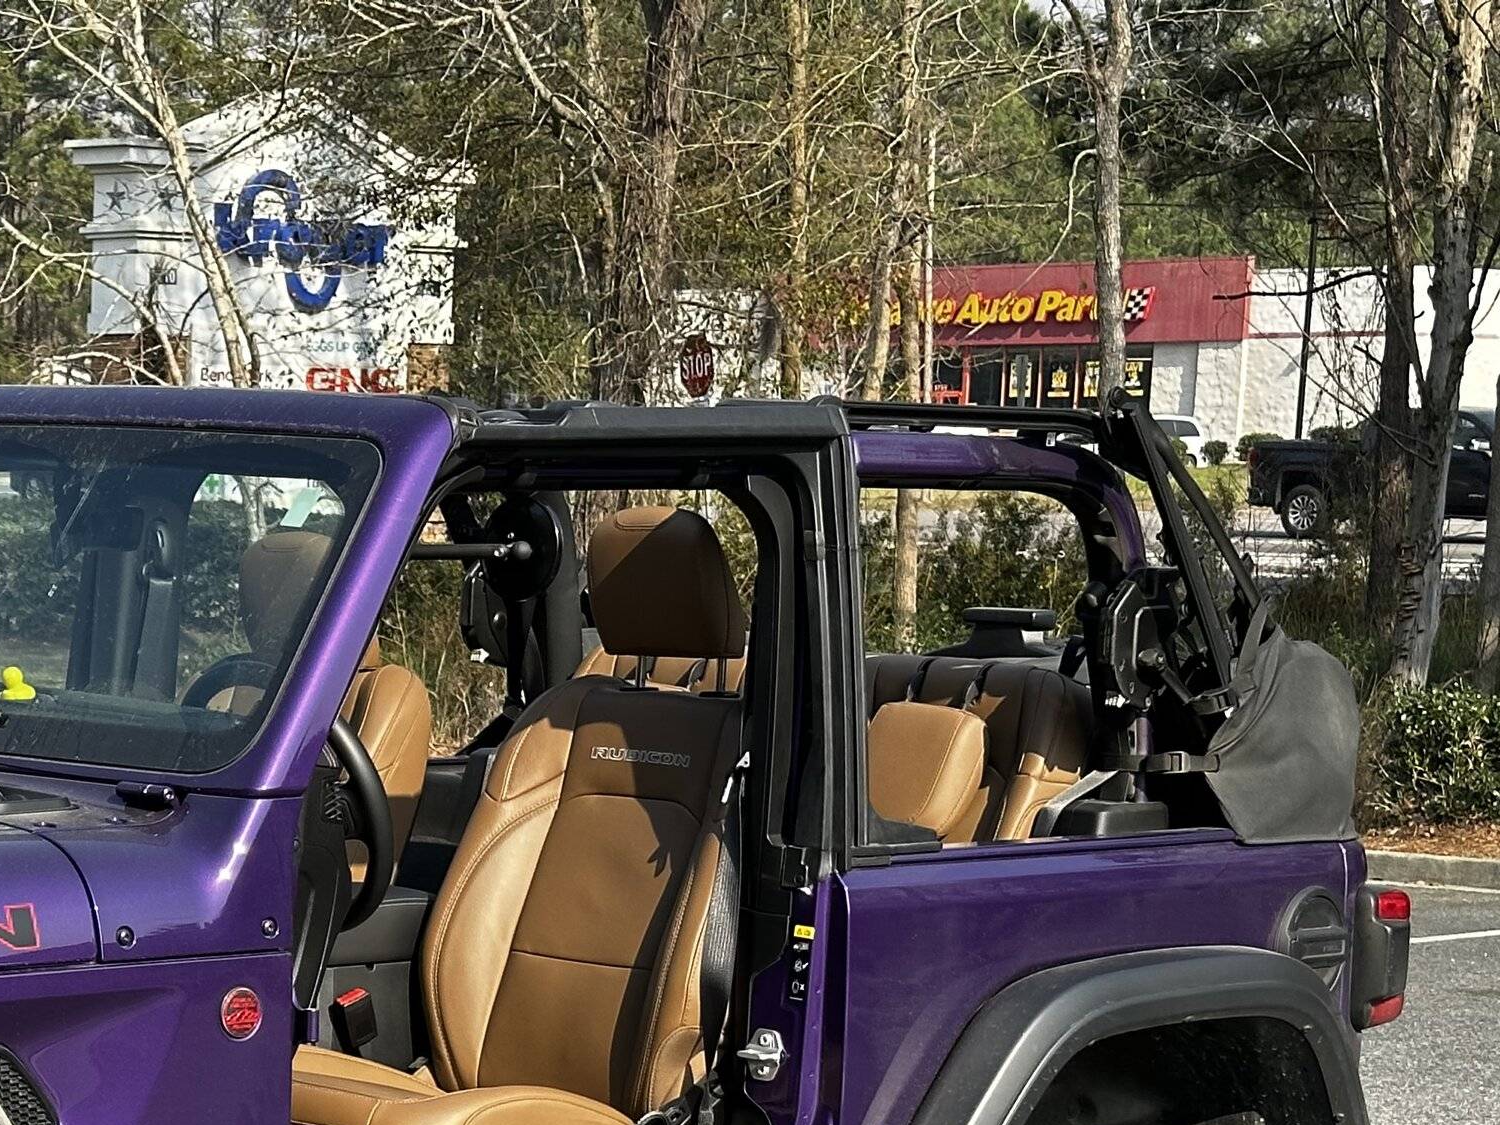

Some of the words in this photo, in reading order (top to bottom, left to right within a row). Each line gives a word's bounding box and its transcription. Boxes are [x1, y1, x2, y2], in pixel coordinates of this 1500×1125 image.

[955, 291, 1033, 325] Auto
[1035, 290, 1098, 323] Par
[305, 366, 400, 394] GNC
[682, 352, 711, 380] STOP
[590, 746, 691, 768] RUBICON
